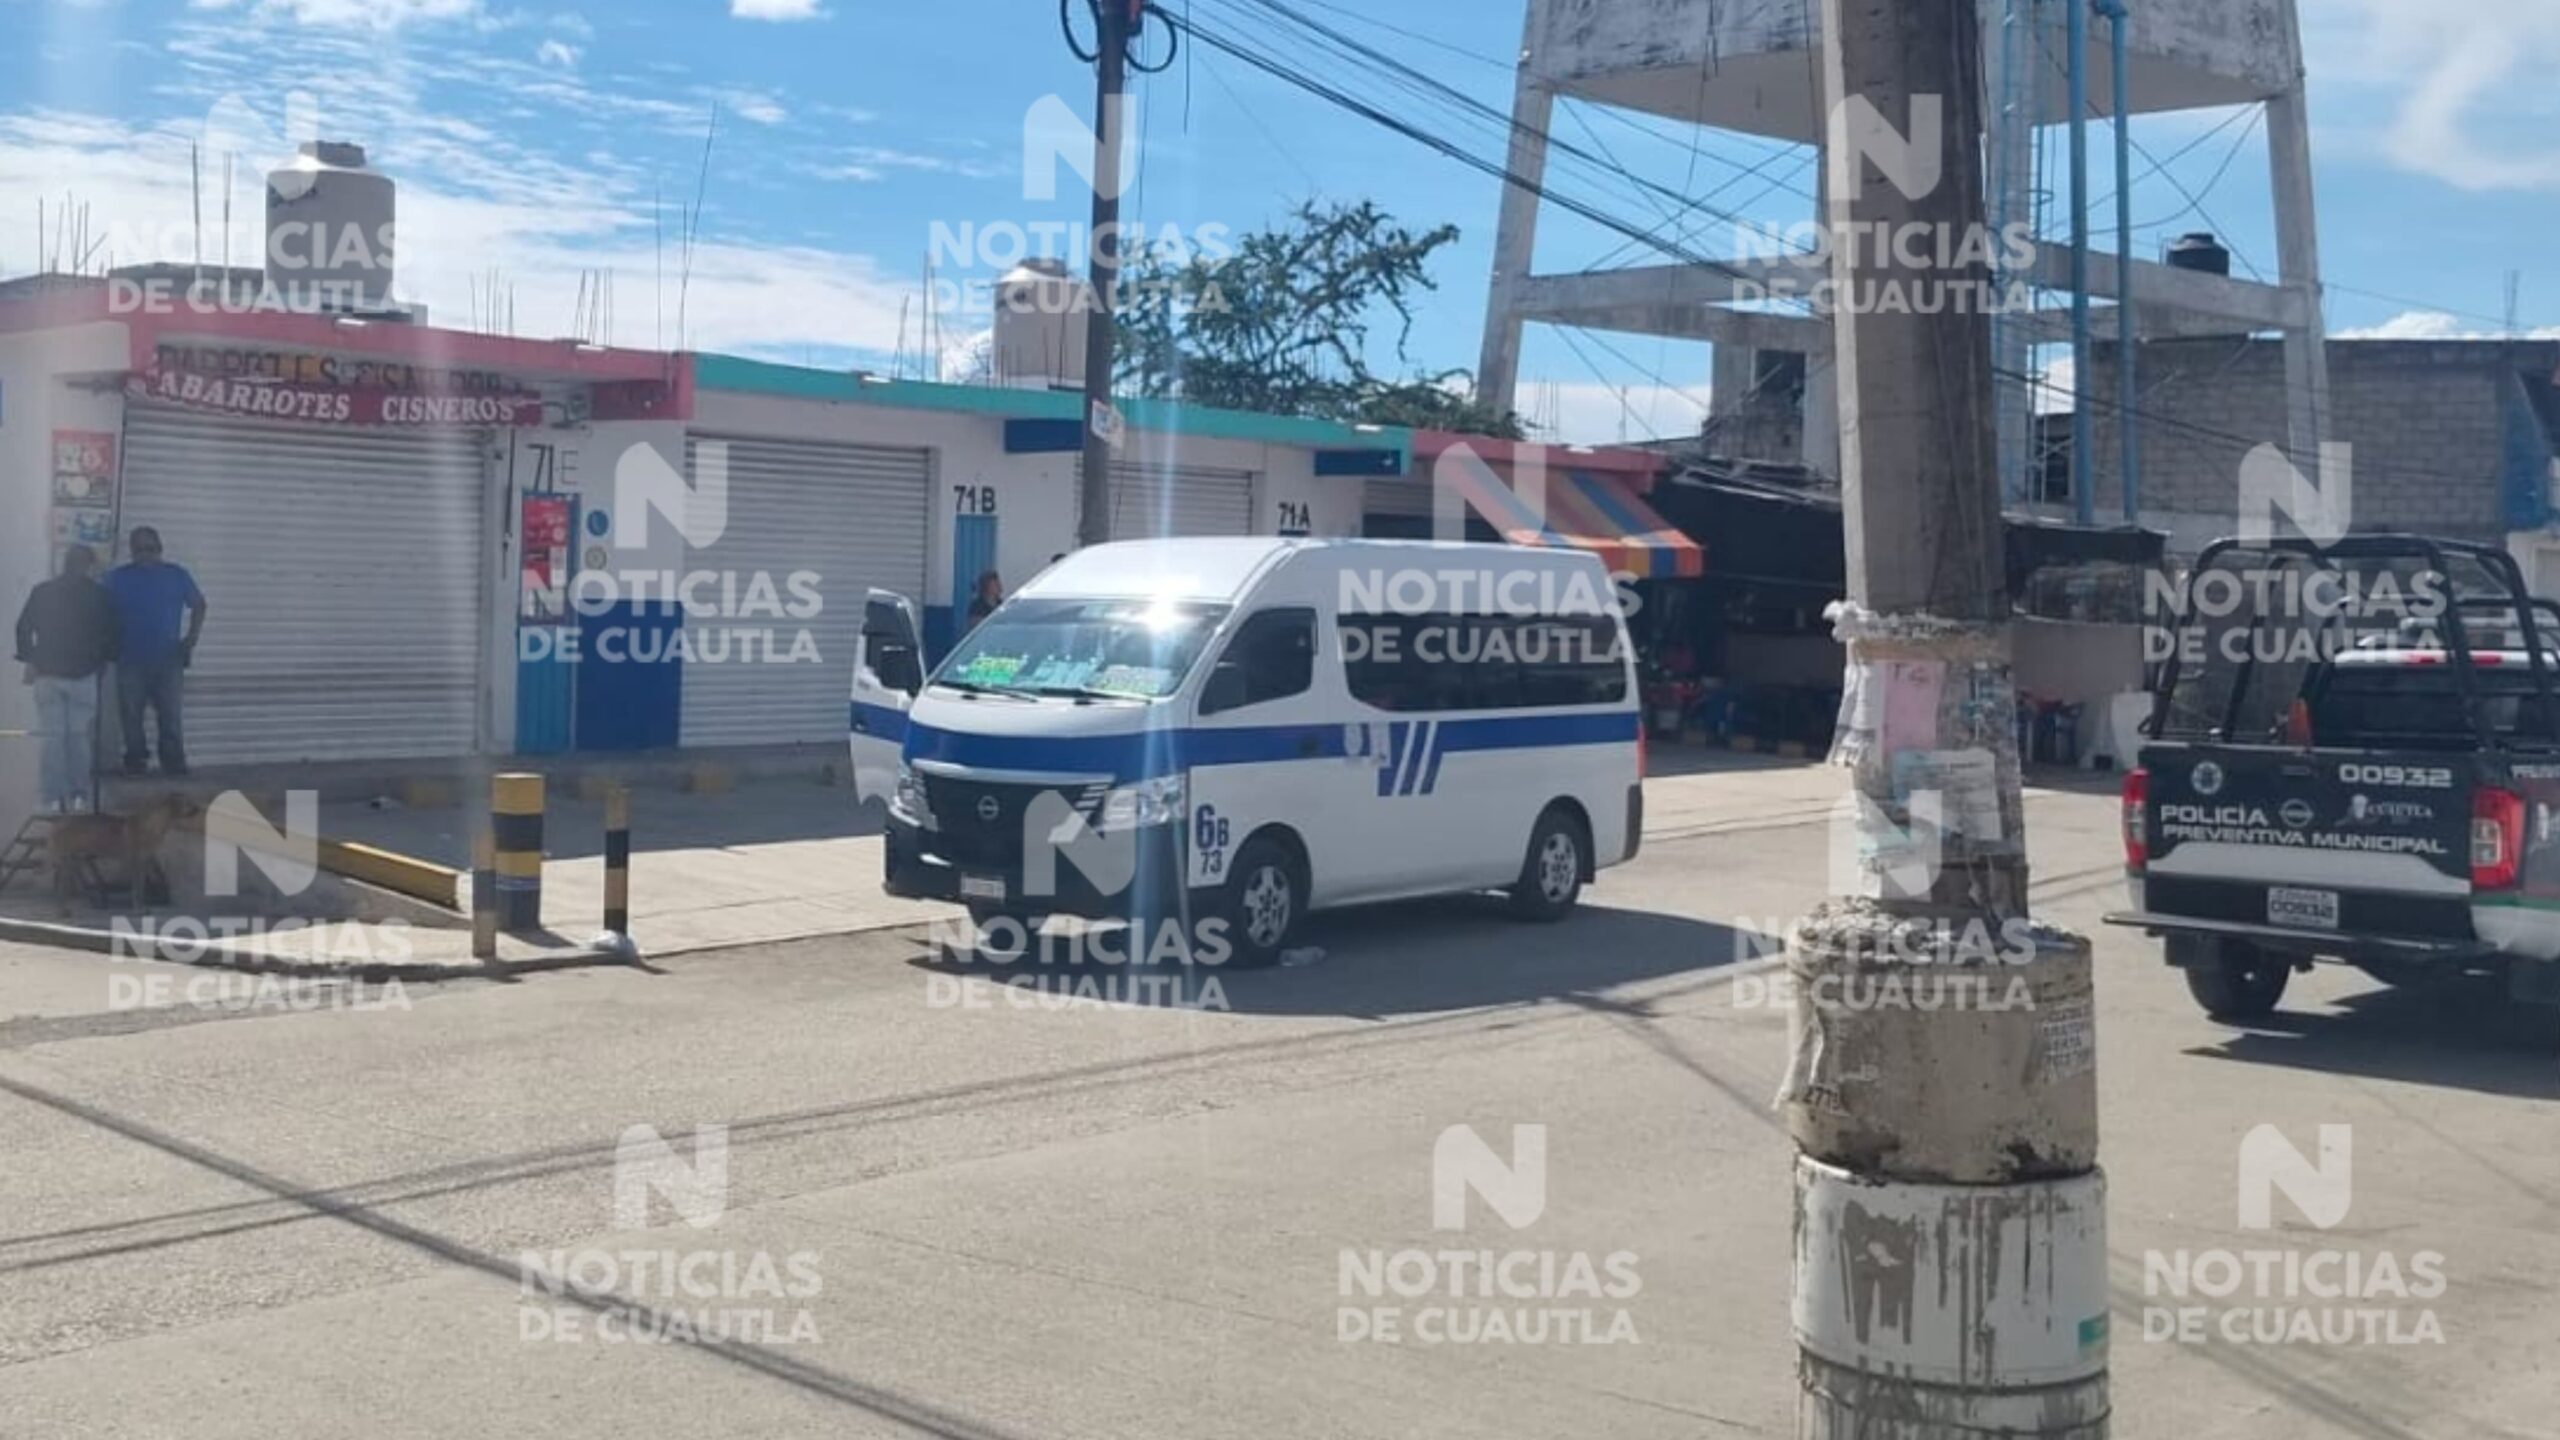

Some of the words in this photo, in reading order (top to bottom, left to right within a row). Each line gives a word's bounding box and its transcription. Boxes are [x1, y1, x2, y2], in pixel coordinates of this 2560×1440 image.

[157, 370, 350, 421] ABARROTES
[381, 394, 514, 423] CISNEROS
[2339, 763, 2452, 788] 00932
[2162, 824, 2305, 845] PREVENTIVA
[2312, 832, 2449, 854] MUNICIPAL
[1200, 849, 1223, 877] 73
